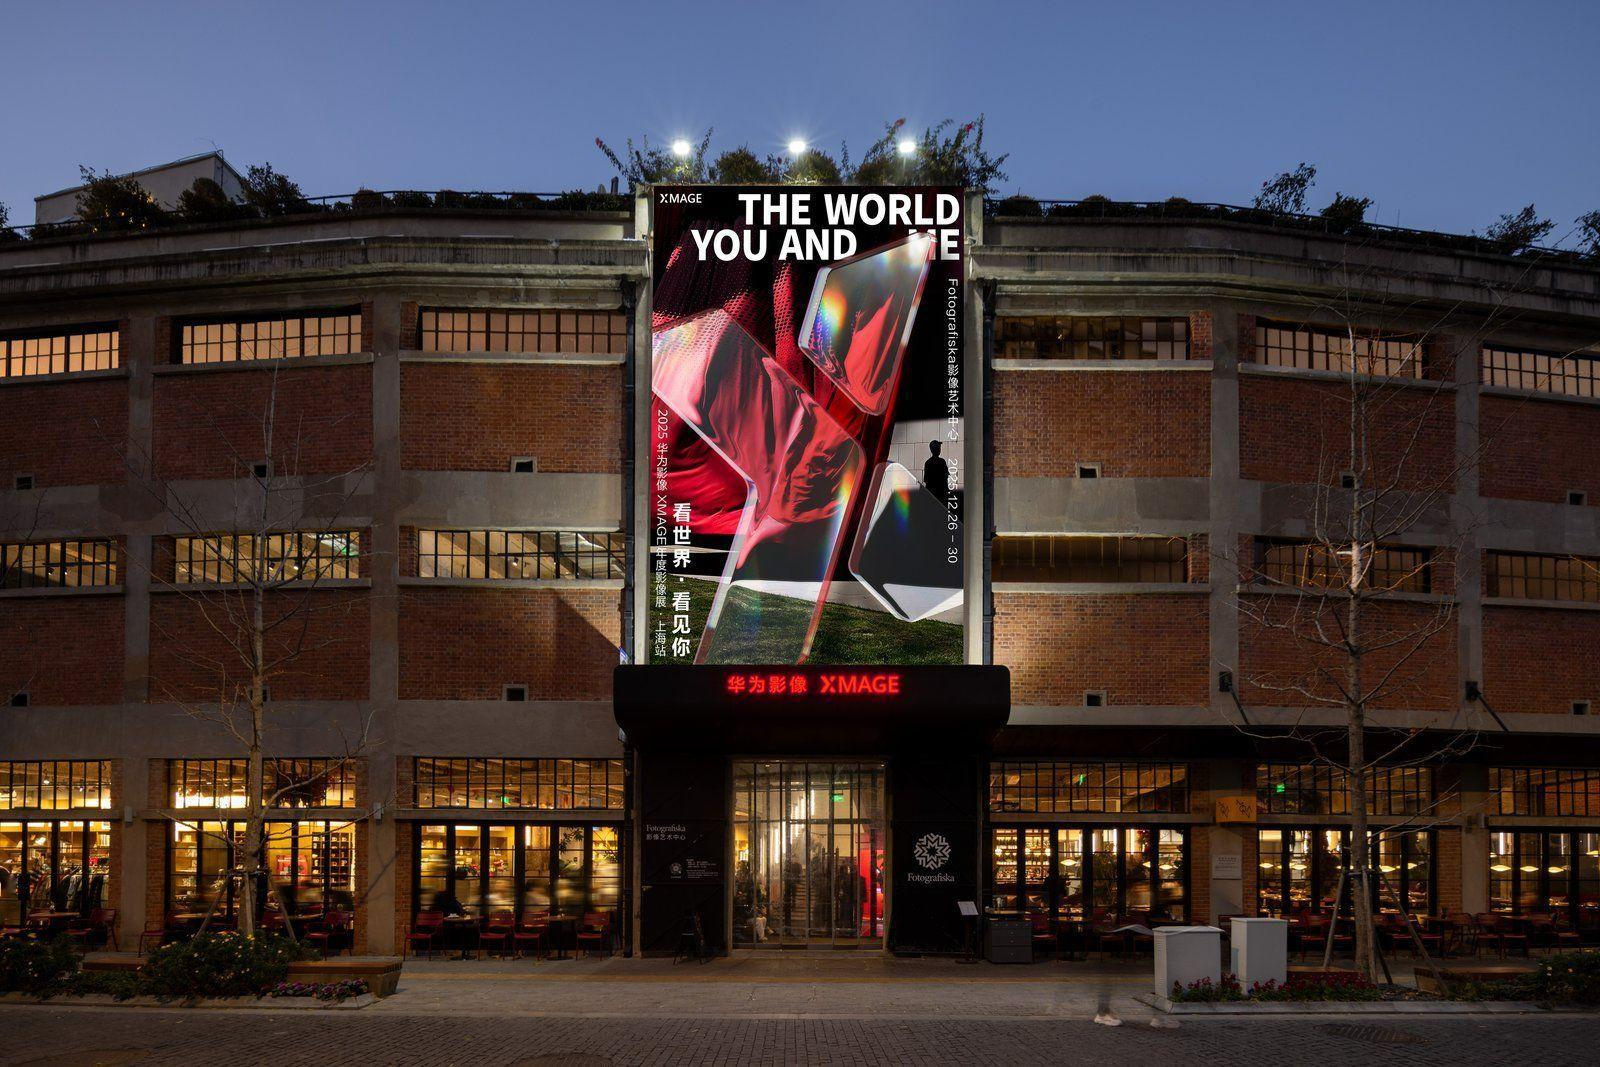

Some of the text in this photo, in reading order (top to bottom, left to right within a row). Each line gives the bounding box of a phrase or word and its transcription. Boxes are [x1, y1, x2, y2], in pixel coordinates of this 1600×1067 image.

[660, 193, 702, 204] XMAGE
[738, 193, 960, 226] THE WORLD
[691, 228, 768, 261] YOU
[778, 228, 857, 261] AND
[657, 409, 668, 439] 2025
[656, 443, 668, 491] 华为影像
[947, 547, 958, 564] 30
[727, 675, 900, 694] 华为影像 XMAGE
[646, 824, 686, 833] Fotografiska
[907, 873, 955, 884] Fotografiska
